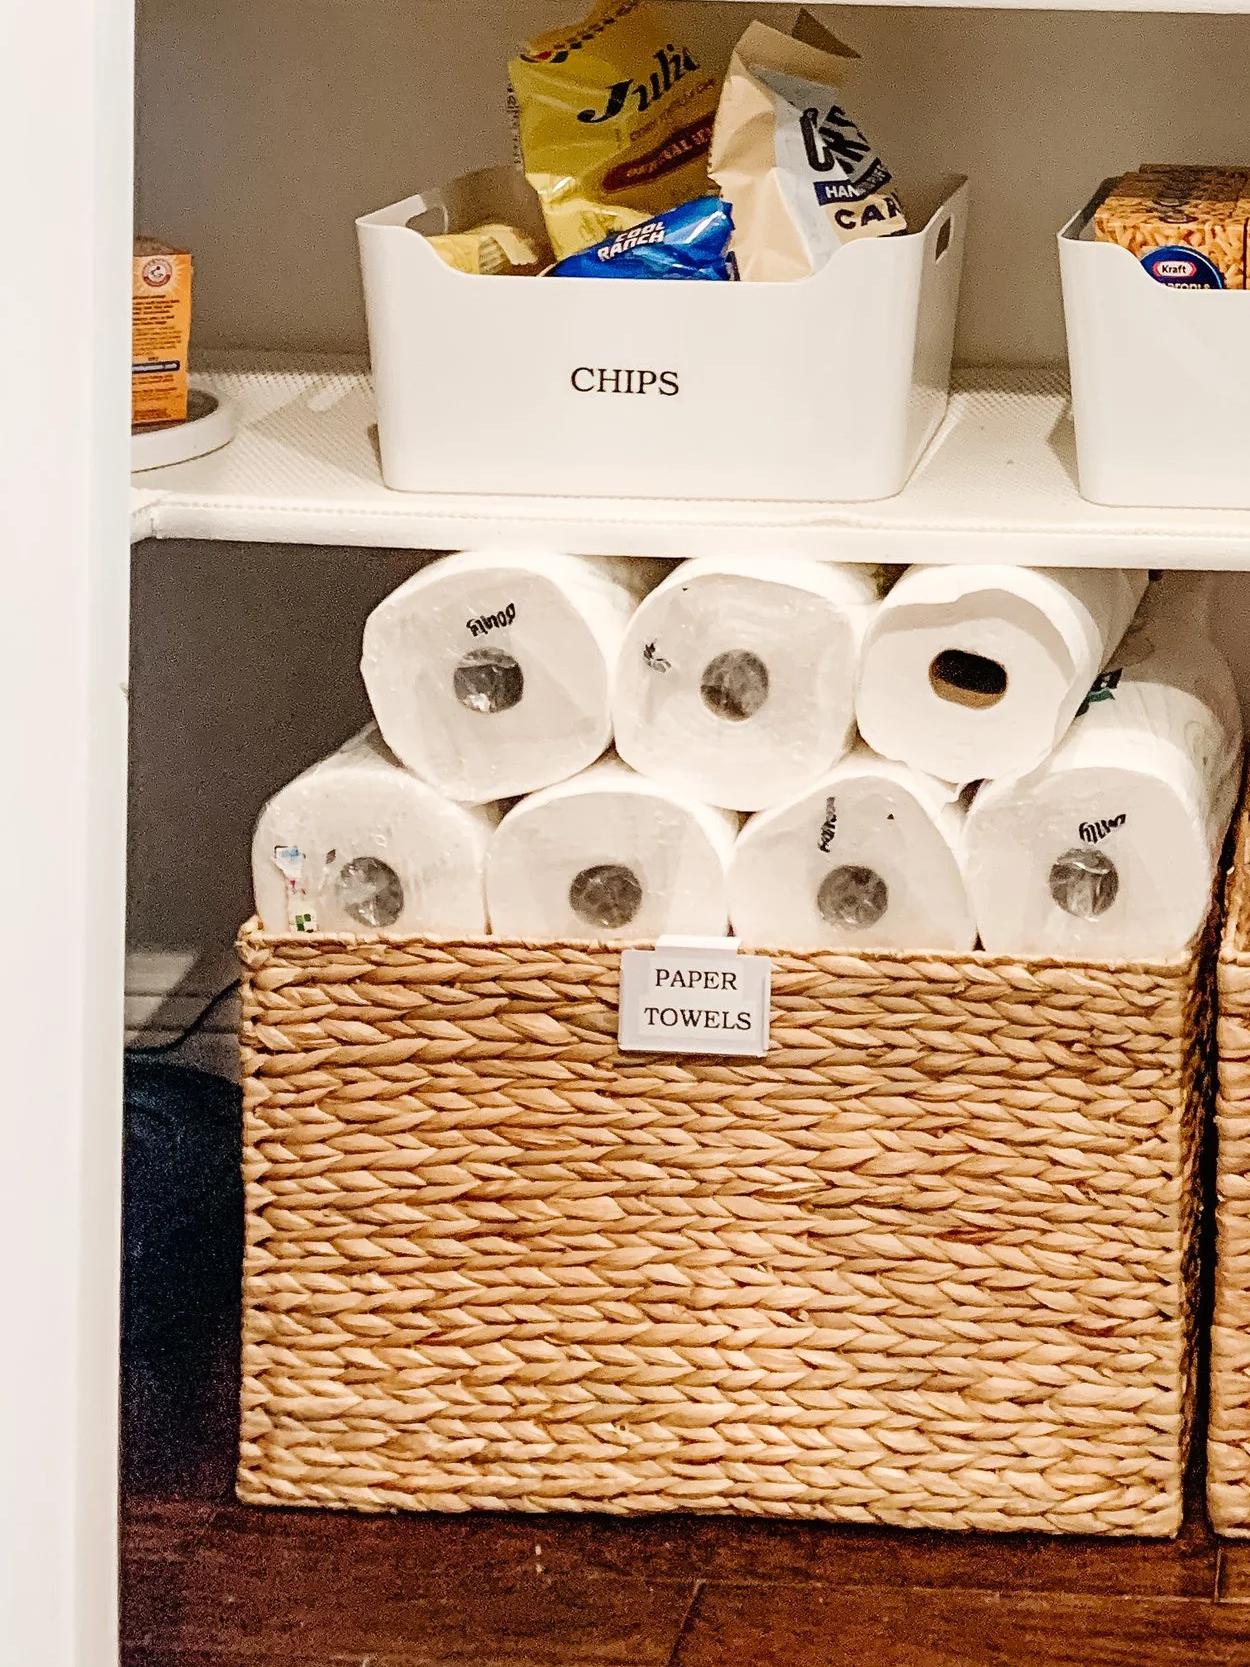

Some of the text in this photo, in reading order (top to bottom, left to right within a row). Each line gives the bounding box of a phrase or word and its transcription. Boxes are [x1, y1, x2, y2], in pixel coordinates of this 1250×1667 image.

[616, 221, 665, 243] COOL
[597, 230, 665, 261] RANCH
[1161, 263, 1188, 274] Kraft
[570, 367, 680, 397] CHIPS
[655, 968, 738, 991] PAPER
[644, 1007, 752, 1031] TOWELS
